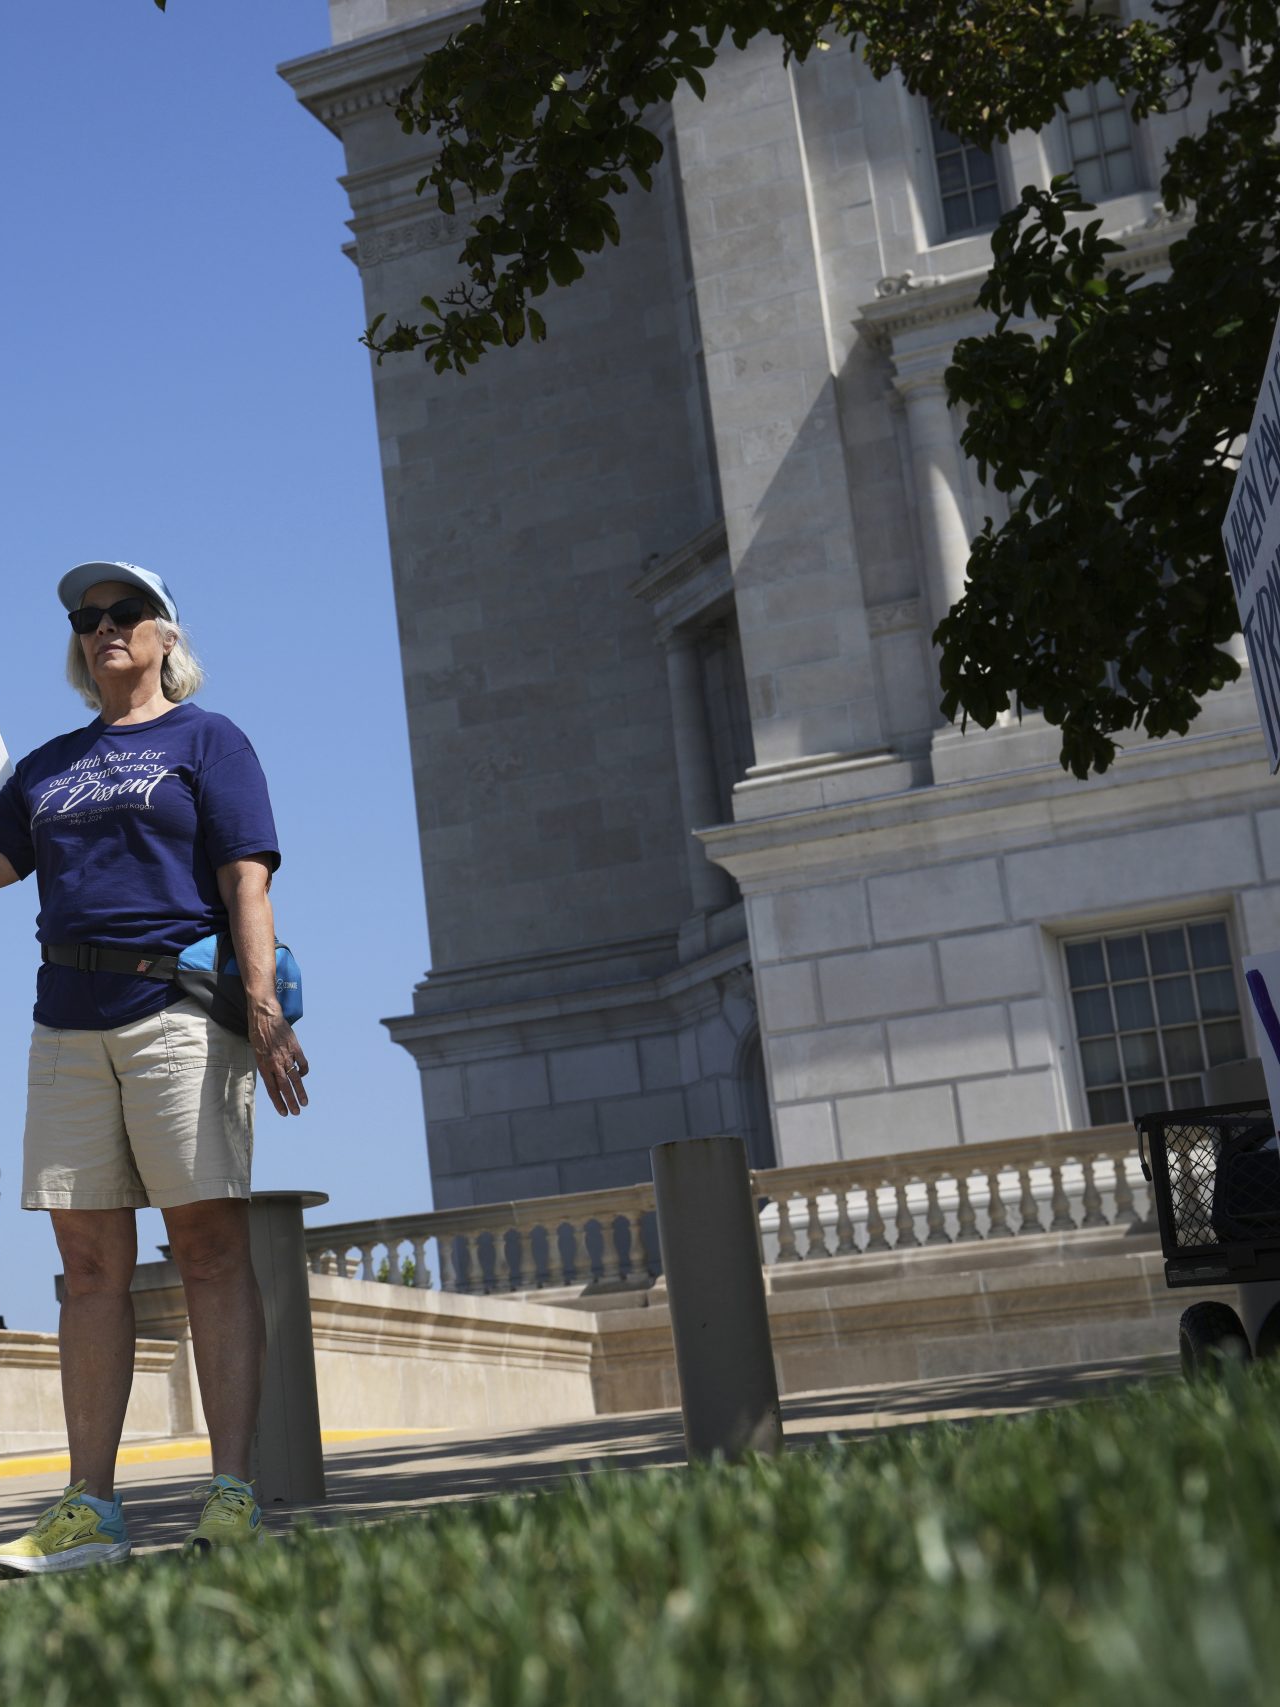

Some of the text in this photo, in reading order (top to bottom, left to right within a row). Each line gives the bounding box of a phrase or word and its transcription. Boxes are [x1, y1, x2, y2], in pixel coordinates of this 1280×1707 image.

[1225, 456, 1267, 599] WHEN
[70, 749, 166, 772] With fear for
[49, 775, 76, 788] our
[30, 769, 180, 831] I Dissent
[129, 802, 155, 811] Kagan
